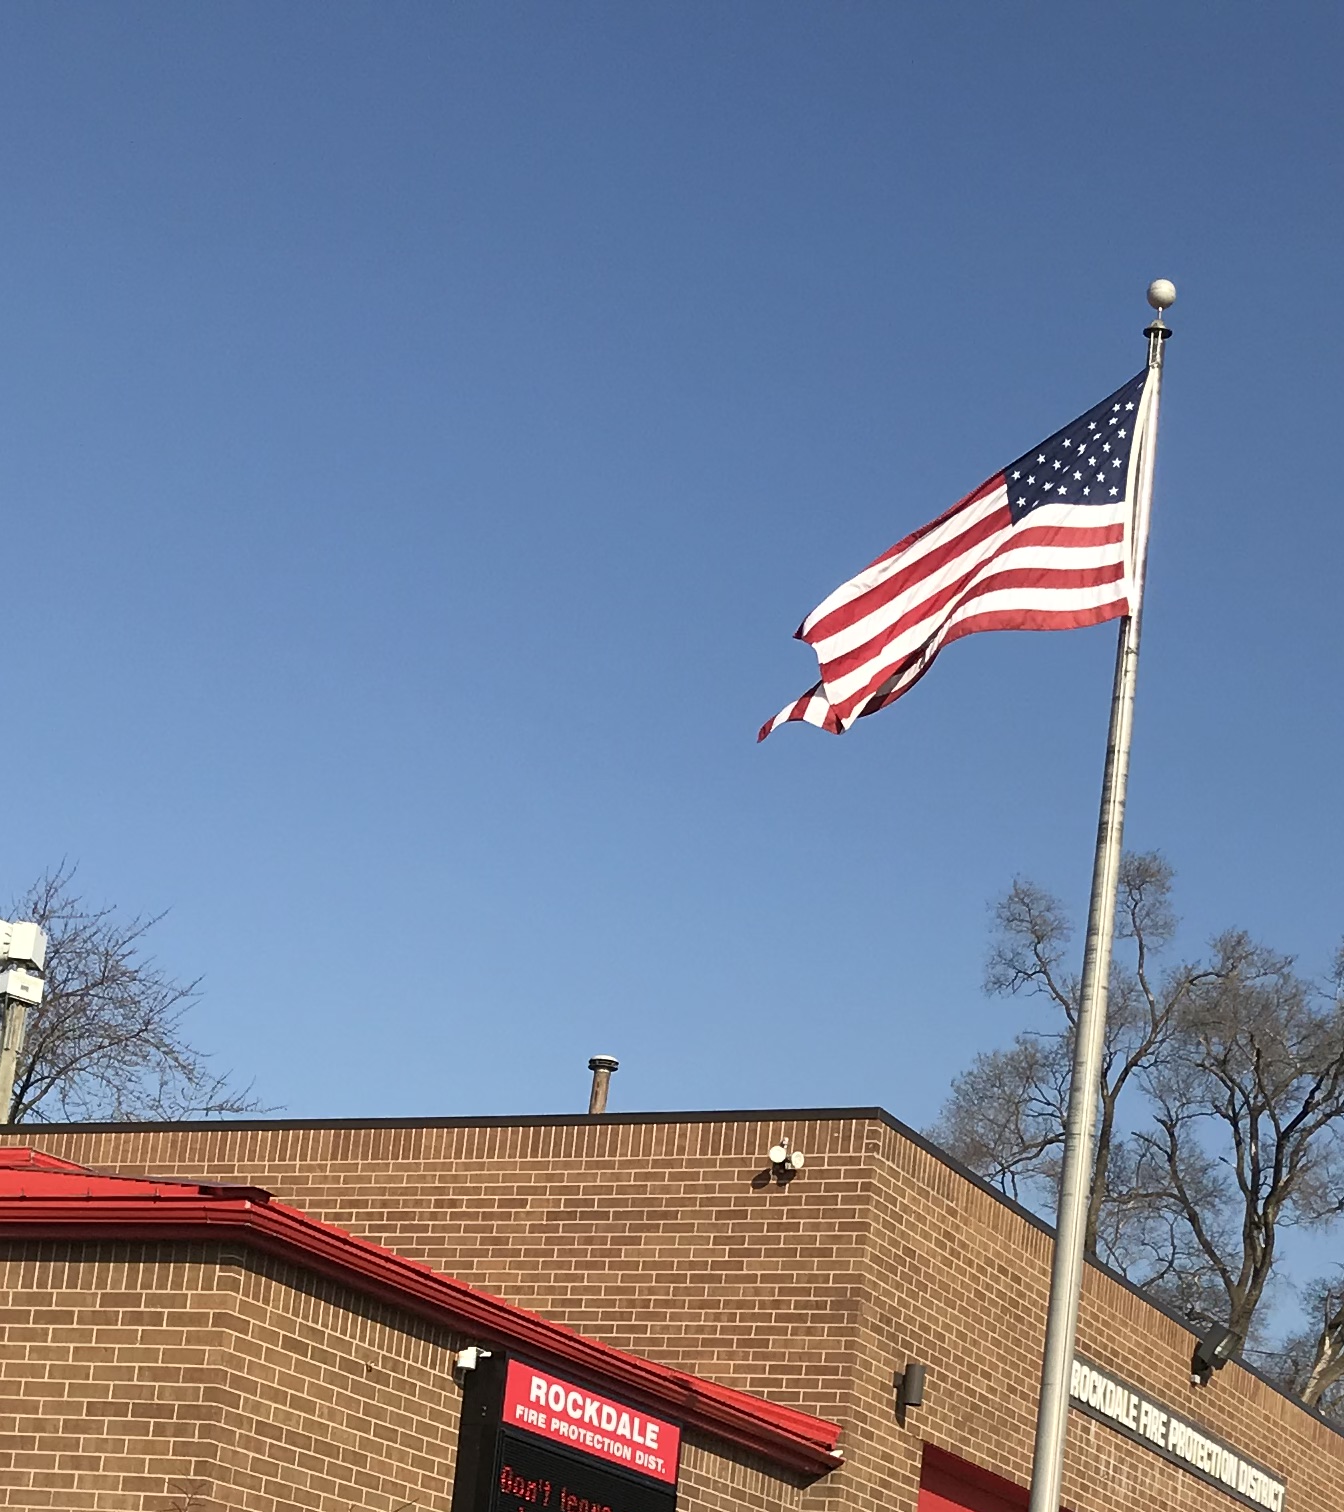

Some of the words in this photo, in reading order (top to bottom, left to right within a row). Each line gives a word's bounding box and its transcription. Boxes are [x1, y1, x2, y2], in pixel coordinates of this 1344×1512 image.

[515, 1404, 547, 1430] FIRE
[550, 1416, 632, 1462] PROTECTION
[635, 1448, 666, 1474] DIST.
[529, 1375, 660, 1450] ROCKDALE
[1070, 1359, 1139, 1431] ROCKDALE
[1139, 1400, 1168, 1448] FIRE
[1168, 1416, 1239, 1489] PROTECTION
[500, 1465, 552, 1507] Don't
